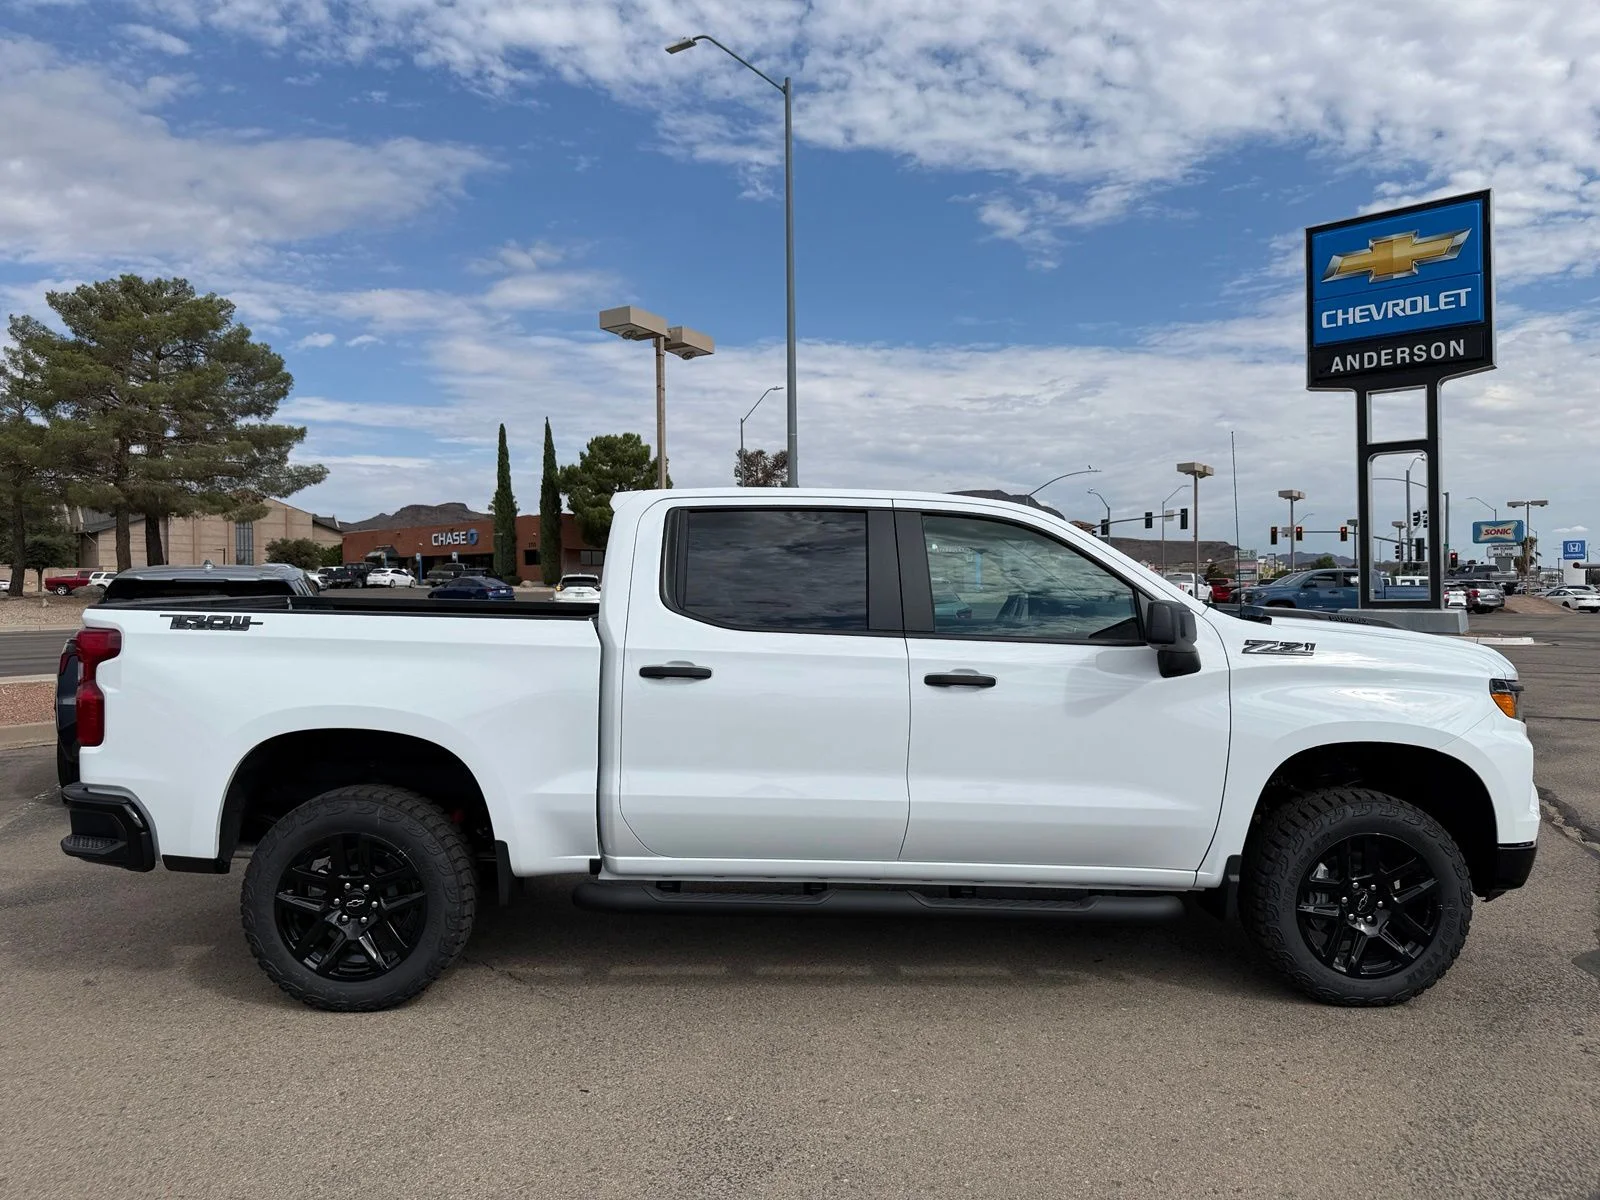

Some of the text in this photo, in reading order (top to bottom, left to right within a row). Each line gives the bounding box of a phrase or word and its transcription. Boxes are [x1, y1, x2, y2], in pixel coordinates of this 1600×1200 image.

[1321, 287, 1472, 329] CHEVROLET
[1330, 338, 1465, 373] ANDERSON
[431, 531, 467, 546] CHASE
[1483, 527, 1512, 536] SONIC
[1241, 639, 1316, 657] Z71
